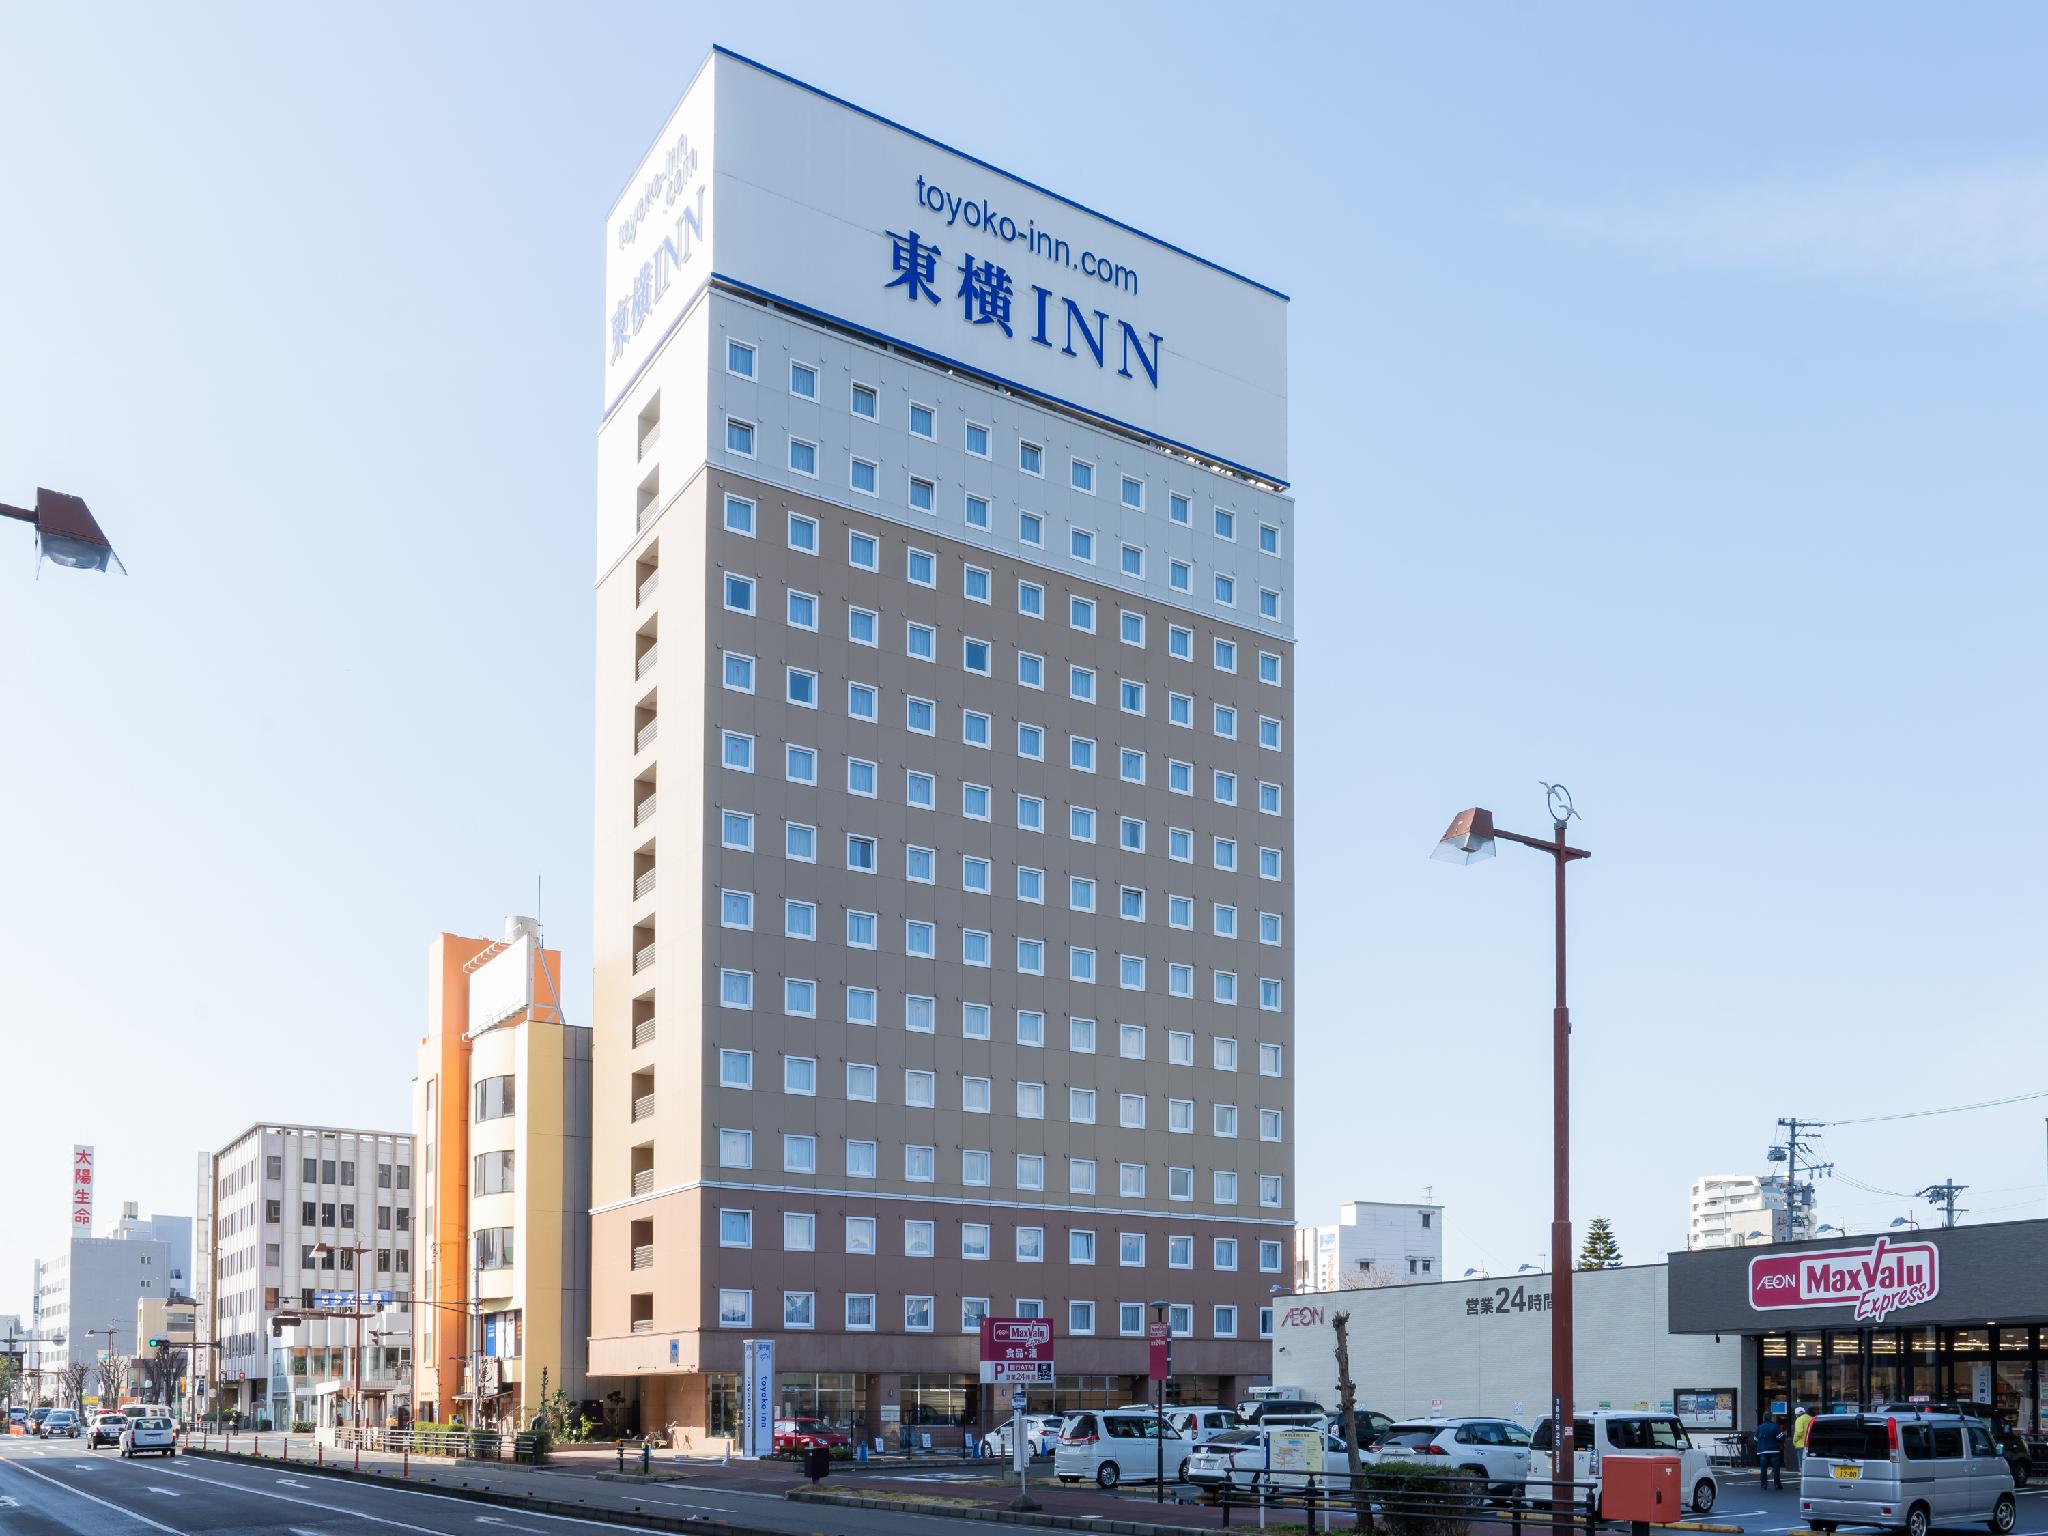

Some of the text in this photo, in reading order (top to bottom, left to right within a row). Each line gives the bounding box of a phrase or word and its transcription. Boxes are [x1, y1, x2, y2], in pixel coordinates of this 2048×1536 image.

[916, 174, 1139, 296] toyoko-inn.com
[74, 1149, 92, 1225] 太陽生命
[1806, 1239, 1923, 1294] MaxValu
[1857, 1282, 1928, 1321] Express
[994, 1362, 1006, 1381] P
